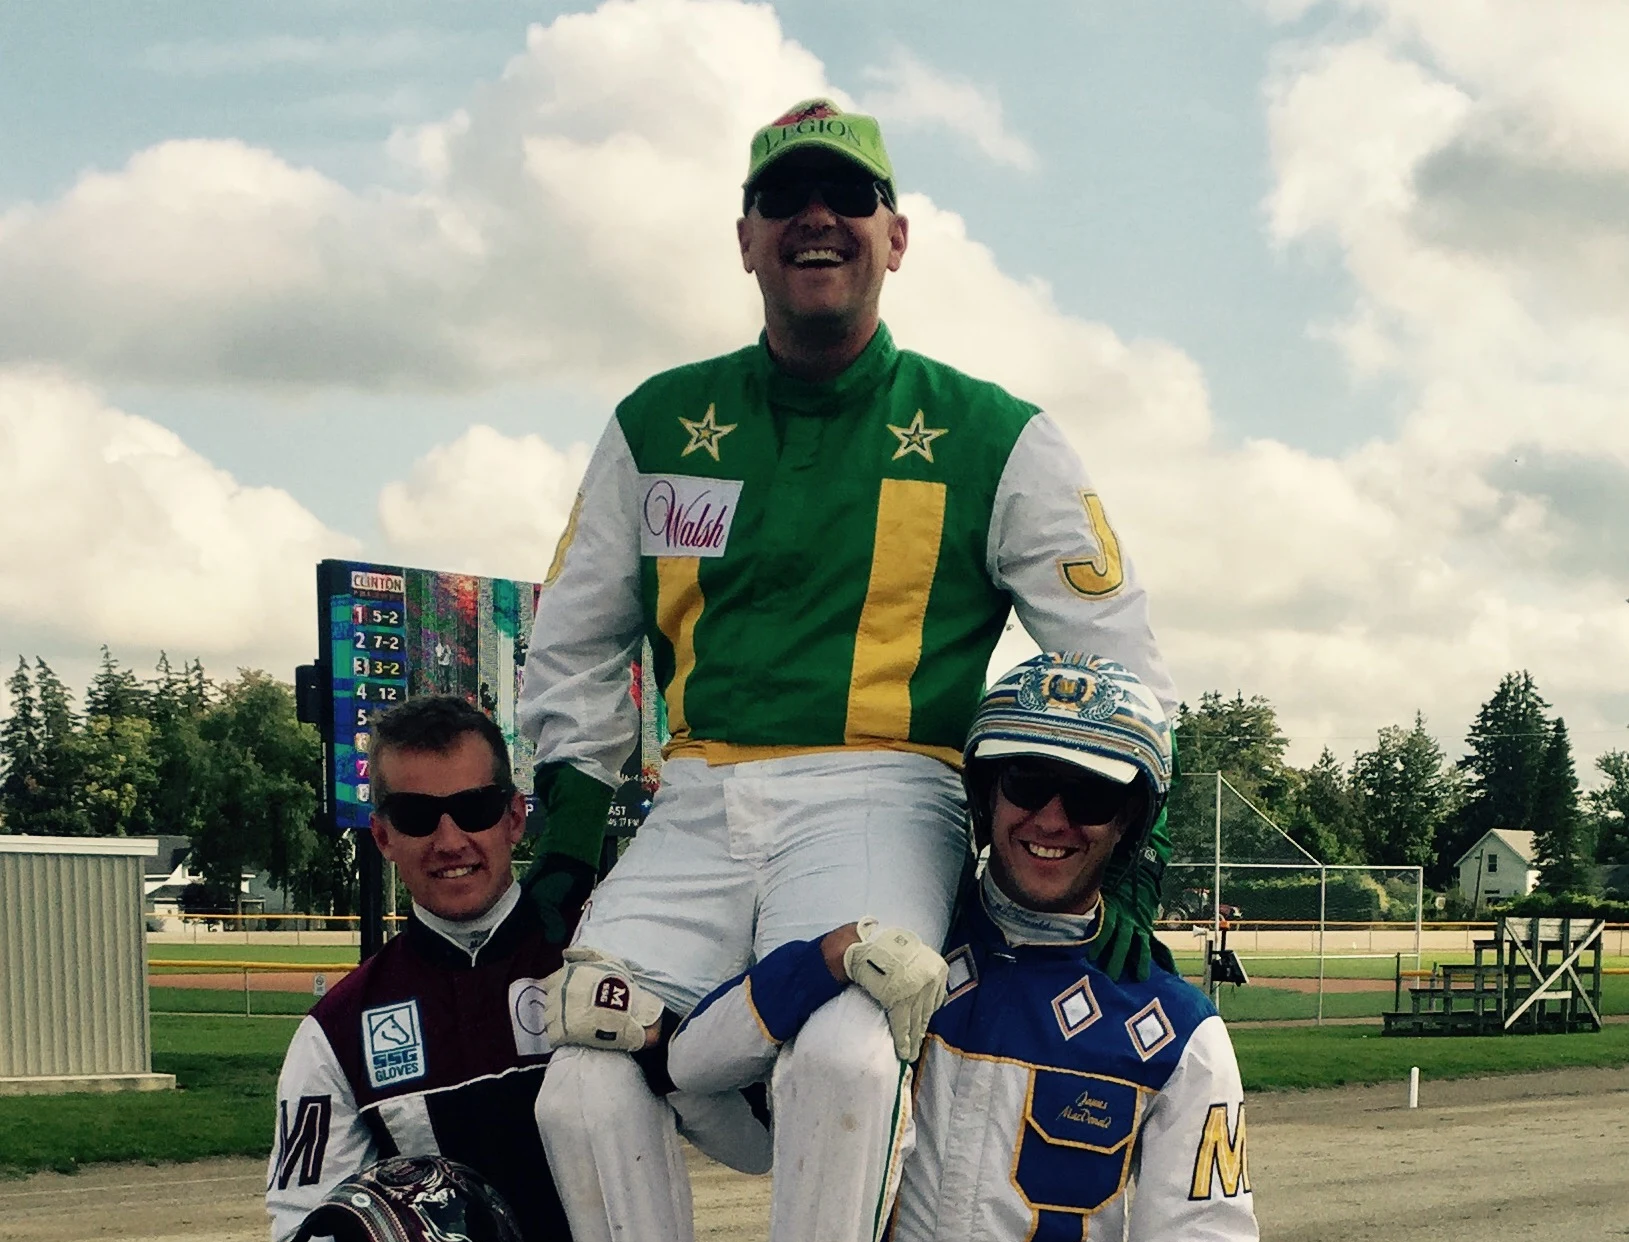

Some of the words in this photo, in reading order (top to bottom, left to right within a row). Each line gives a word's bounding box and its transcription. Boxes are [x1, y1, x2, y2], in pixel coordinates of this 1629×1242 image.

[763, 119, 862, 154] LEGION
[644, 480, 728, 548] Walsh
[1058, 491, 1124, 599] J
[354, 574, 402, 591] CLINTON
[356, 606, 363, 624] 1
[373, 610, 399, 624] 5-2
[354, 632, 366, 649] 2
[373, 635, 400, 650] 7-2
[355, 657, 366, 676] 3
[374, 661, 401, 675] 3-2
[356, 683, 368, 700] 4
[379, 687, 397, 700] 12
[357, 708, 368, 726] 5
[358, 759, 369, 777] 7
[373, 1048, 418, 1070] SSG
[375, 1062, 419, 1082] GLOVES
[1188, 1102, 1252, 1201] M
